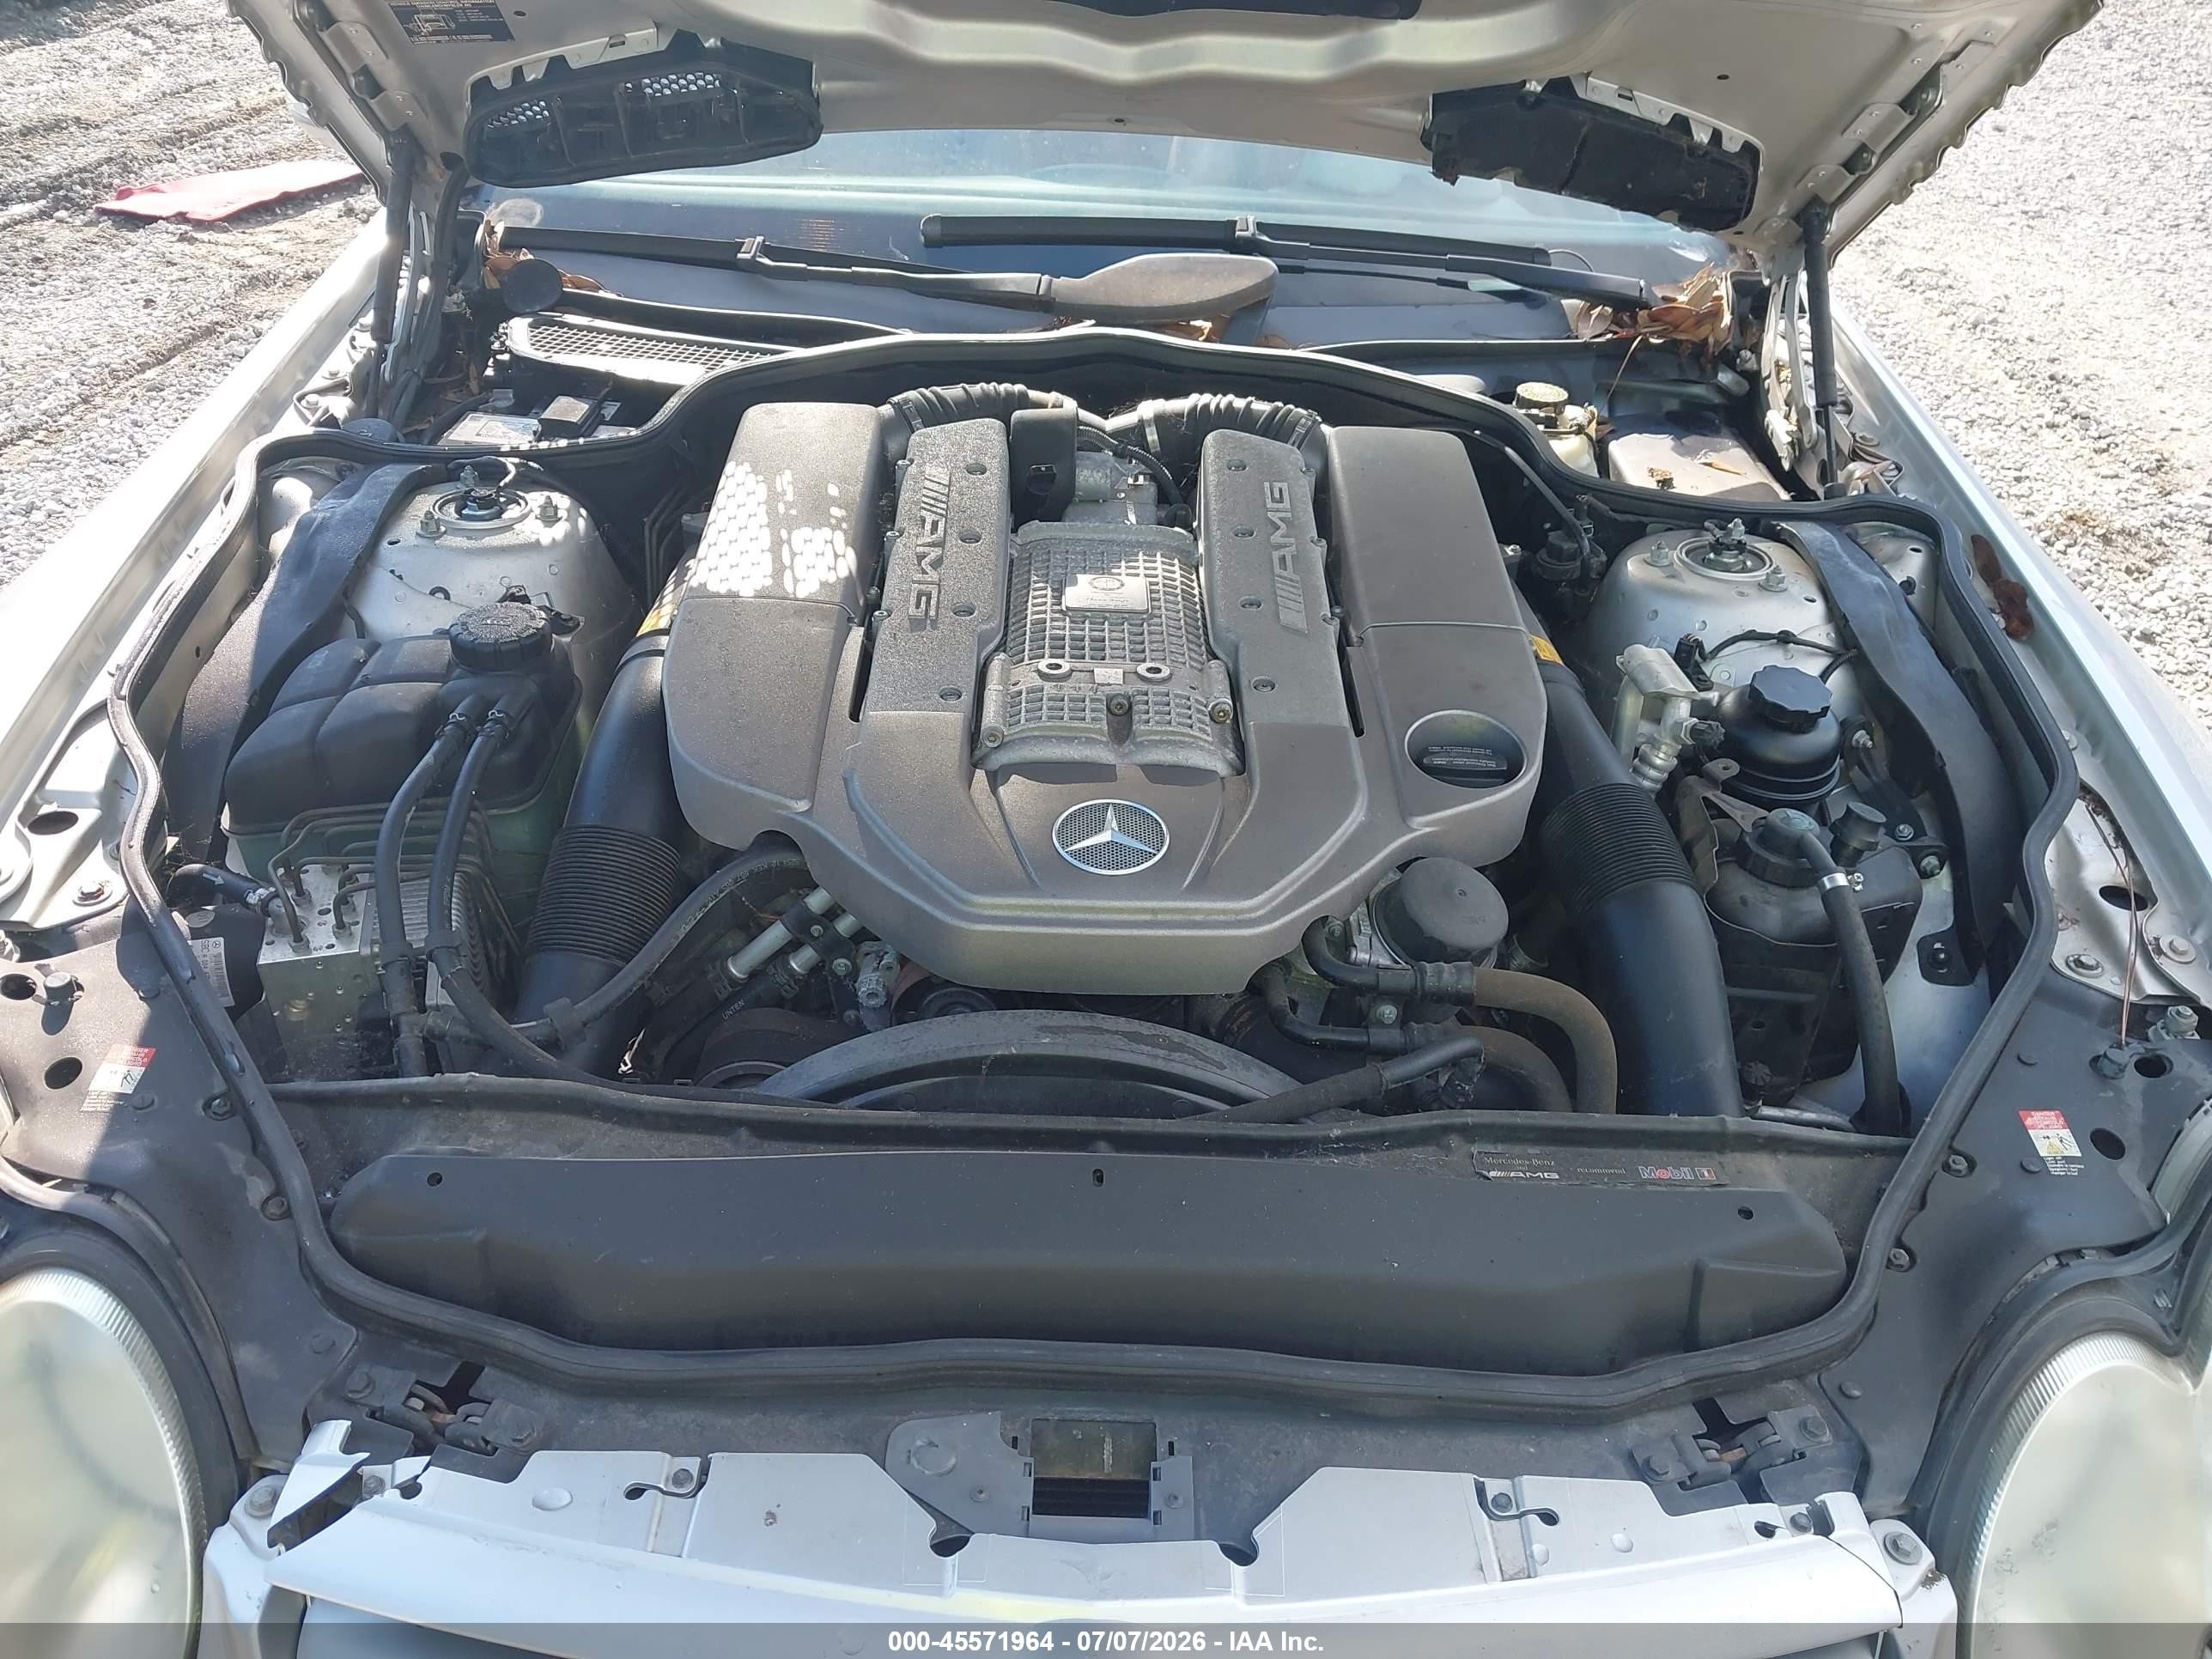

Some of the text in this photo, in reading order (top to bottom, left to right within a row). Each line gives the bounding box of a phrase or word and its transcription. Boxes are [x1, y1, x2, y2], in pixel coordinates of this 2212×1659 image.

[1264, 482, 1299, 580] AMG
[908, 510, 945, 620] AMG
[201, 940, 210, 953] SBC
[1483, 1157, 1555, 1166] Mercedes-Benz
[1577, 1167, 1626, 1176] recommend
[1638, 1166, 1695, 1180] Mobil
